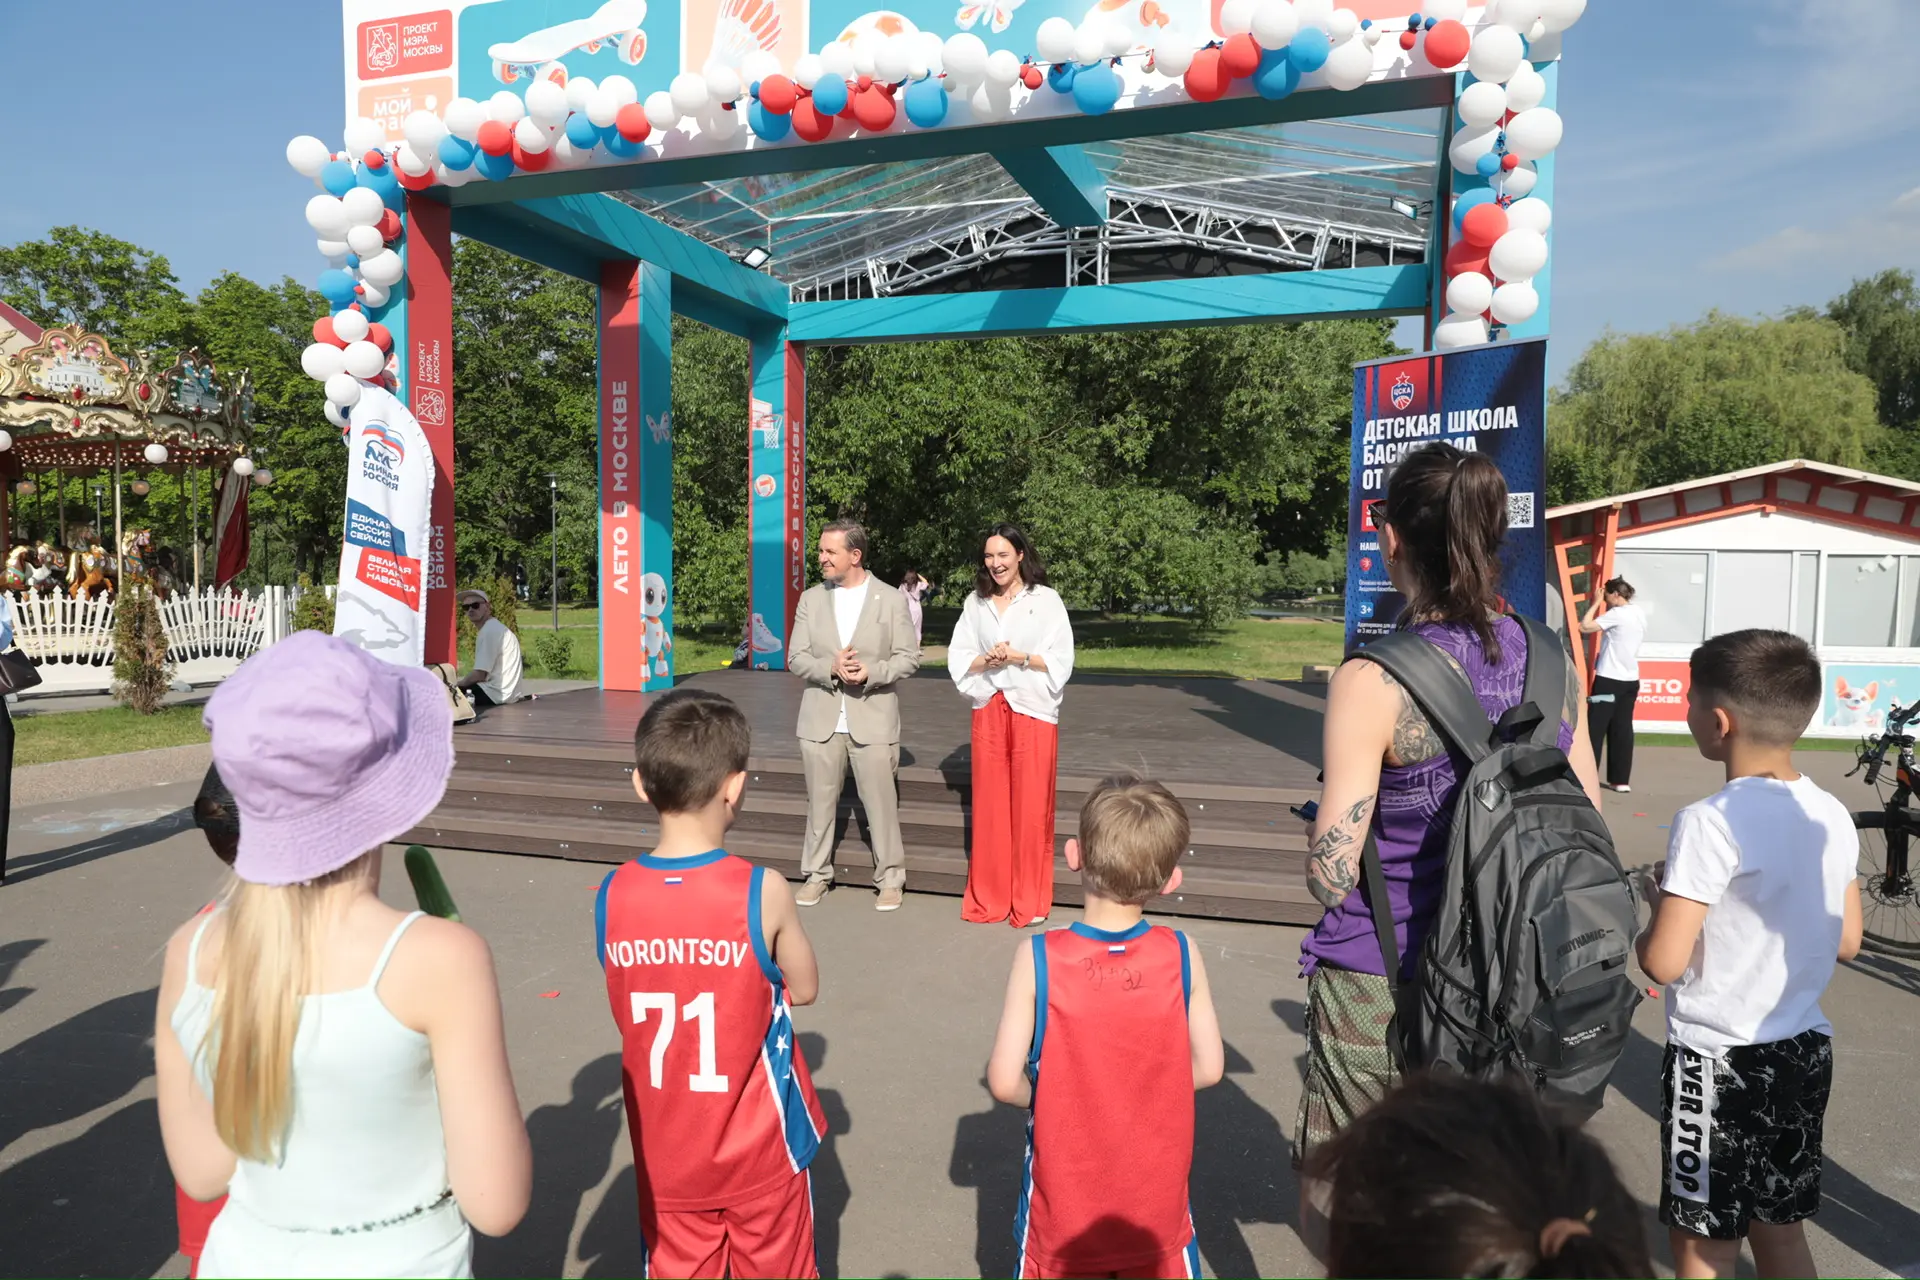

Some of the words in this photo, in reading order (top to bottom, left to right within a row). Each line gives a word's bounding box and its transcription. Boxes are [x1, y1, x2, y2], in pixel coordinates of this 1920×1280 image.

[404, 22, 438, 36] ПРОЕКТ
[404, 35, 428, 46] МЭРА
[404, 44, 443, 58] МОСКВЫ
[418, 341, 426, 382] ПРОЕКТ
[1394, 387, 1412, 396] ЦСКА
[1363, 413, 1440, 445] ДЕТСКАЯ
[1448, 406, 1518, 433] ШКОЛА
[613, 380, 628, 492] МОСКВЕ
[363, 460, 400, 482] ЕДИНАЯ
[792, 420, 800, 510] МОСКВЕ
[363, 470, 398, 491] РОССИЯ
[1362, 468, 1383, 490] ОТ
[613, 502, 628, 518] В
[351, 522, 392, 540] РОССИЯ
[352, 513, 392, 530] ЕДИНАЯ
[792, 517, 800, 531] В
[350, 530, 390, 547] СЕЙЧАС
[368, 554, 412, 574] ВЕЛИАЯ
[613, 526, 628, 594] ЛЕТО
[366, 572, 416, 592] НАВСЕДА
[1360, 605, 1372, 614] 3+
[1640, 679, 1682, 694] ЕТО
[606, 938, 748, 968] VORONTSOV
[630, 992, 728, 1092] 71
[1680, 1048, 1703, 1114] EVER
[1676, 1119, 1702, 1193] STOP
